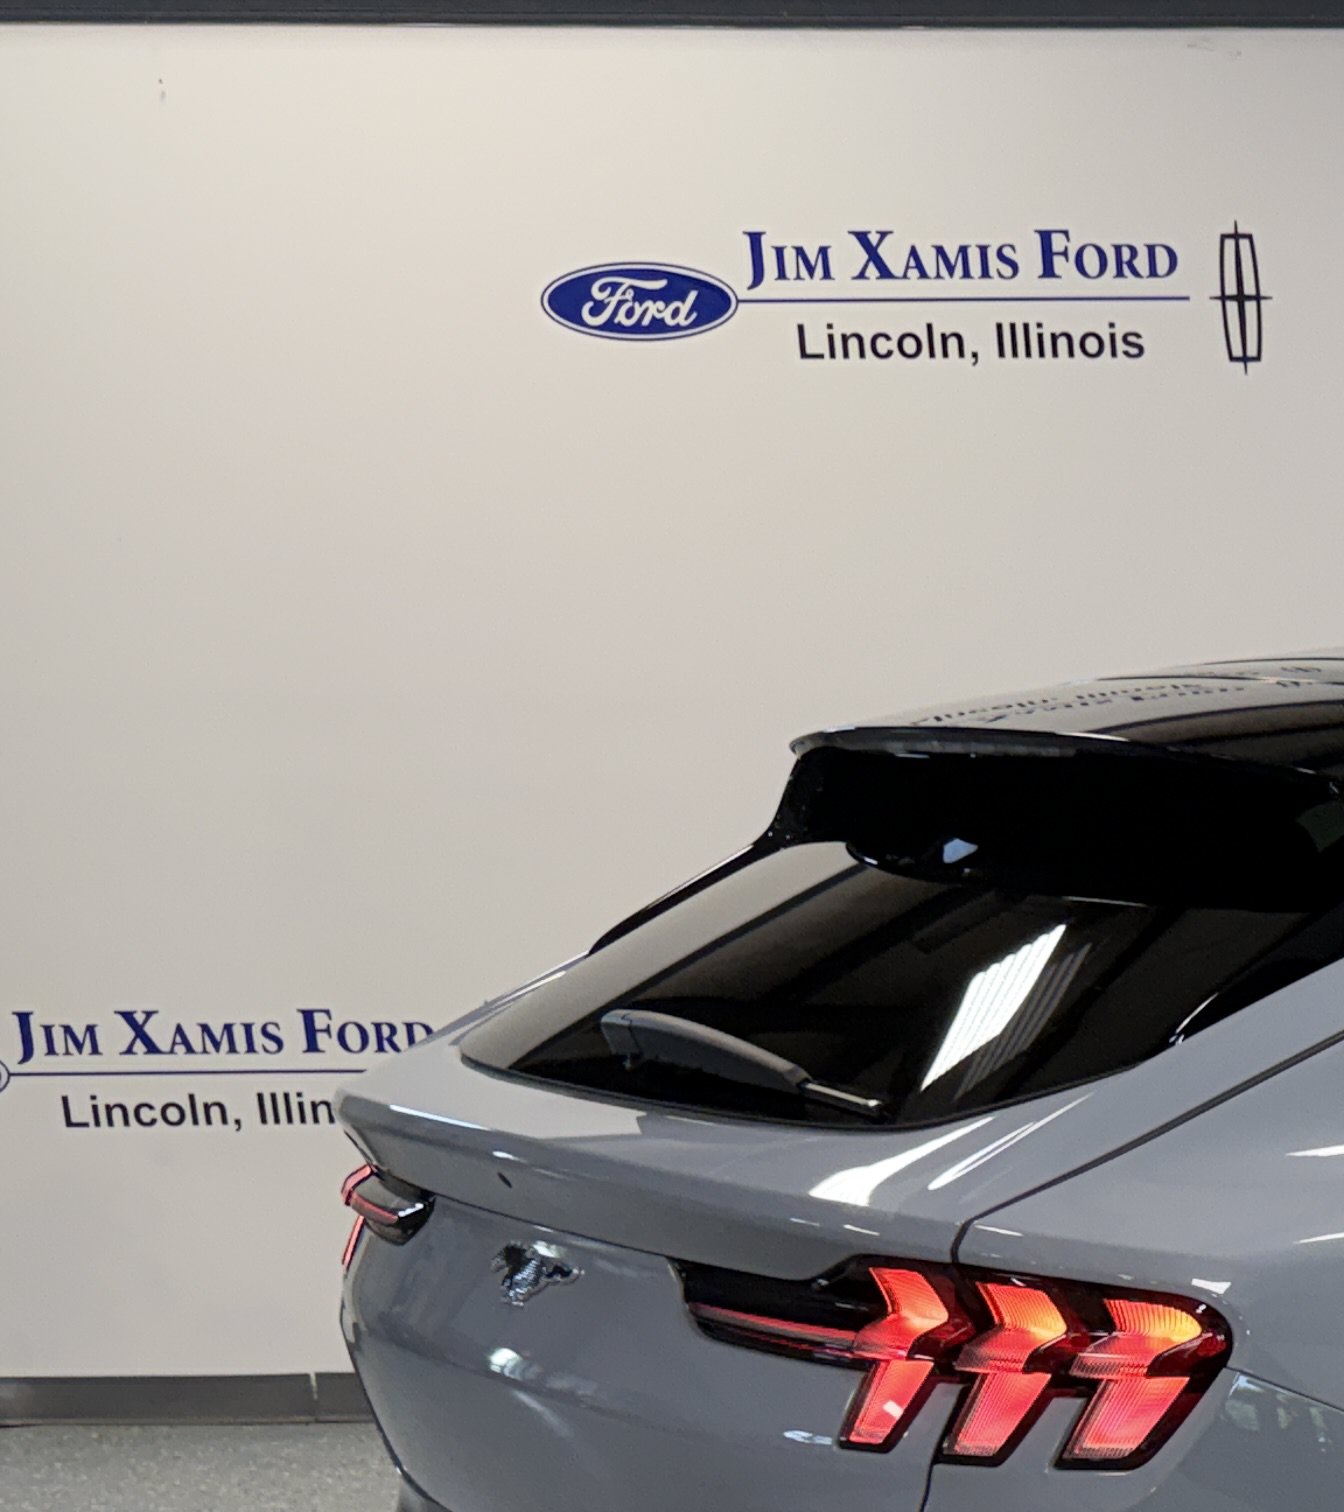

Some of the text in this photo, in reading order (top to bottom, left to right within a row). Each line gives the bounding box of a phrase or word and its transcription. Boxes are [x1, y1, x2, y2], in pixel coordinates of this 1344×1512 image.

[742, 228, 1178, 291] JIM XAMIS FORD
[580, 276, 699, 328] Ford
[796, 322, 1145, 368] Lincoln, Illinois
[12, 1011, 103, 1065] JIM
[114, 1010, 284, 1056] XAMIS
[61, 1092, 336, 1132] Lincoln, Illin
